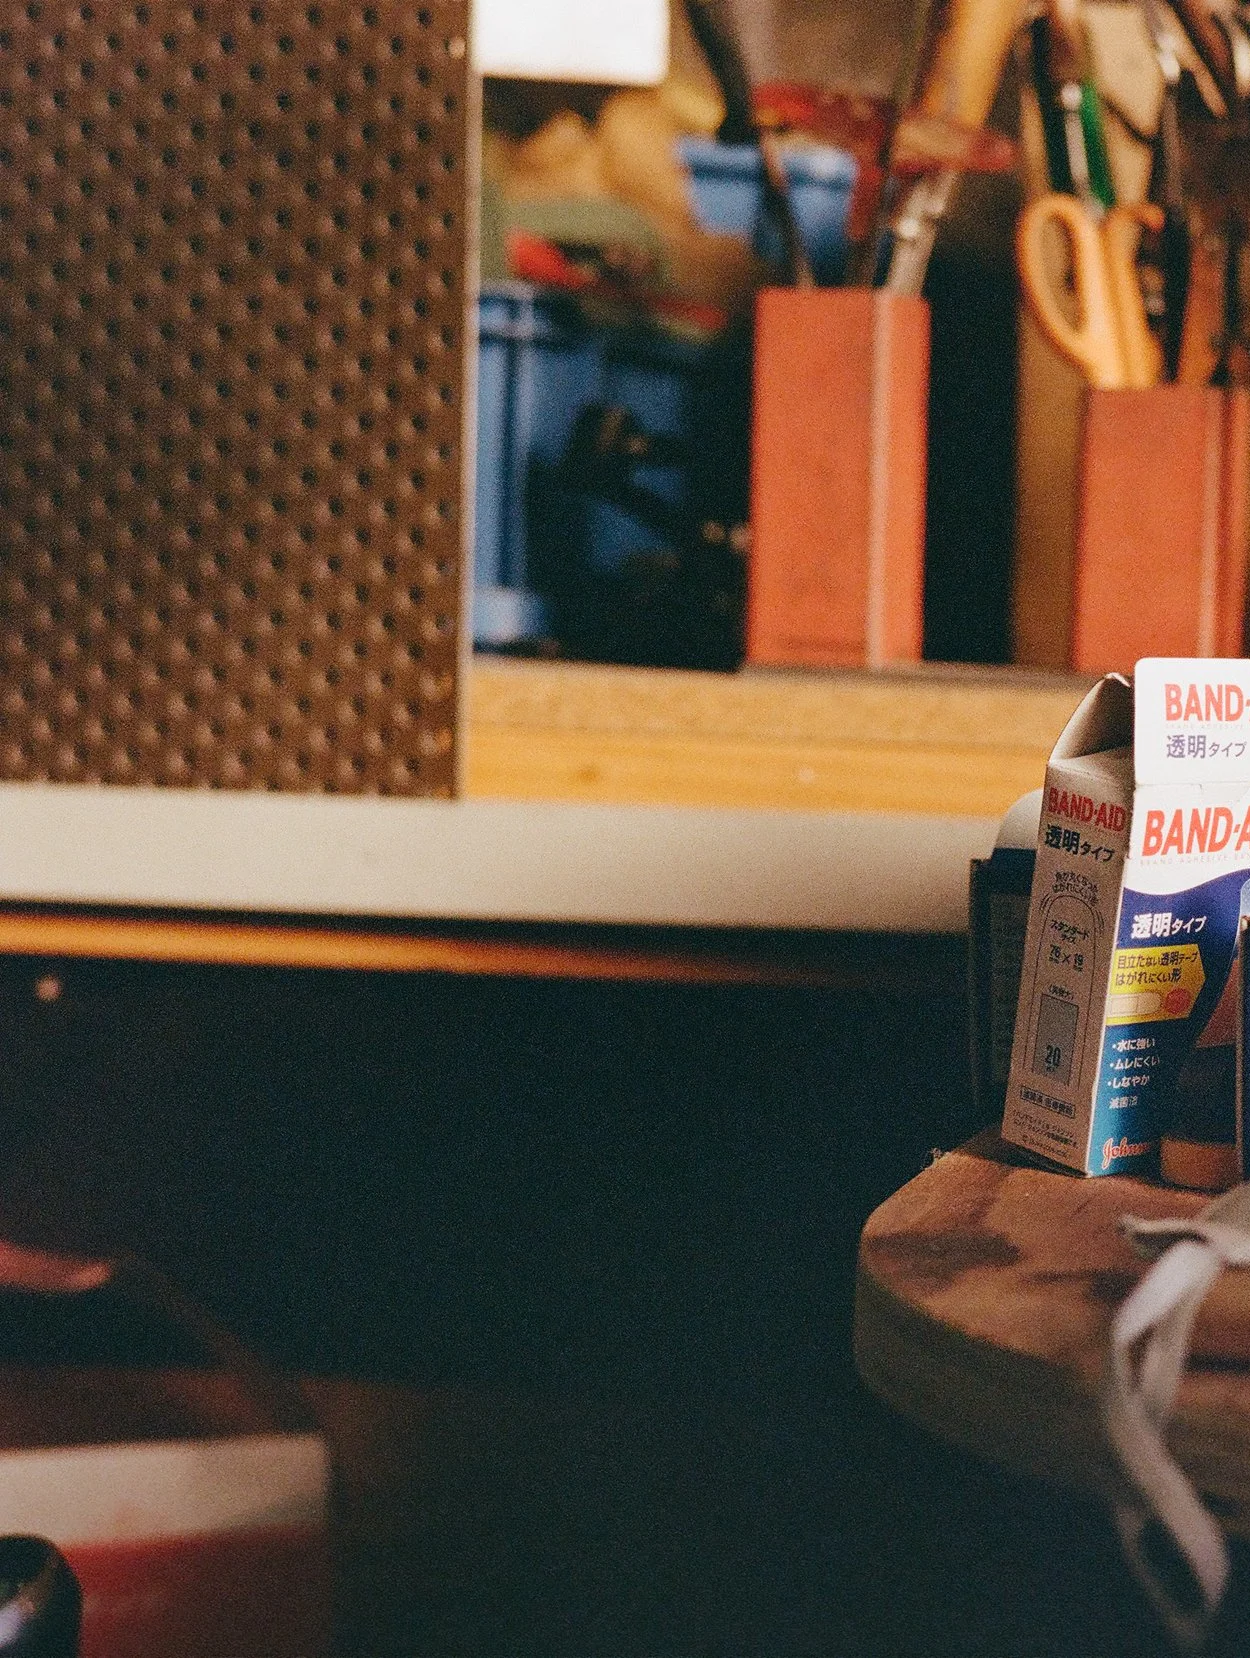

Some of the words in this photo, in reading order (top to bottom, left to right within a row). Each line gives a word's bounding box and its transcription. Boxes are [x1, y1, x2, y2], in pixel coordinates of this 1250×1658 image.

[1166, 734, 1248, 759] 透明タイプ
[1045, 823, 1116, 862] 透明タイプ
[1130, 912, 1207, 939] 透明タイプ
[1115, 967, 1182, 986] はがれにくい形
